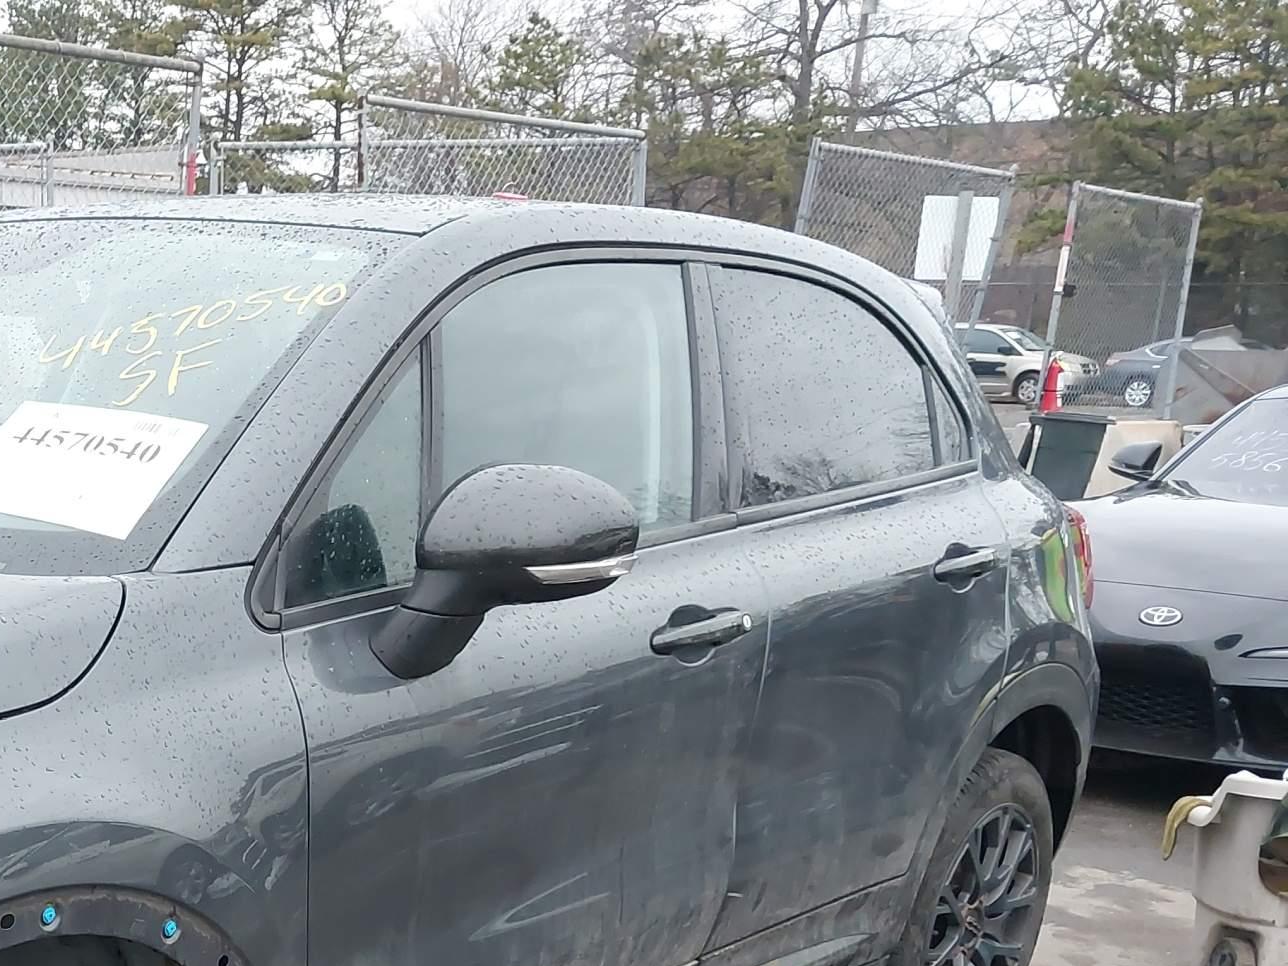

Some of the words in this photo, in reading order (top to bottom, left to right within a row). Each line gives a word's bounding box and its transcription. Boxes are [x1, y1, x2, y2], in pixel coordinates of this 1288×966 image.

[38, 283, 348, 368] 44570540
[112, 339, 224, 407] SF
[13, 426, 161, 464] 44570540
